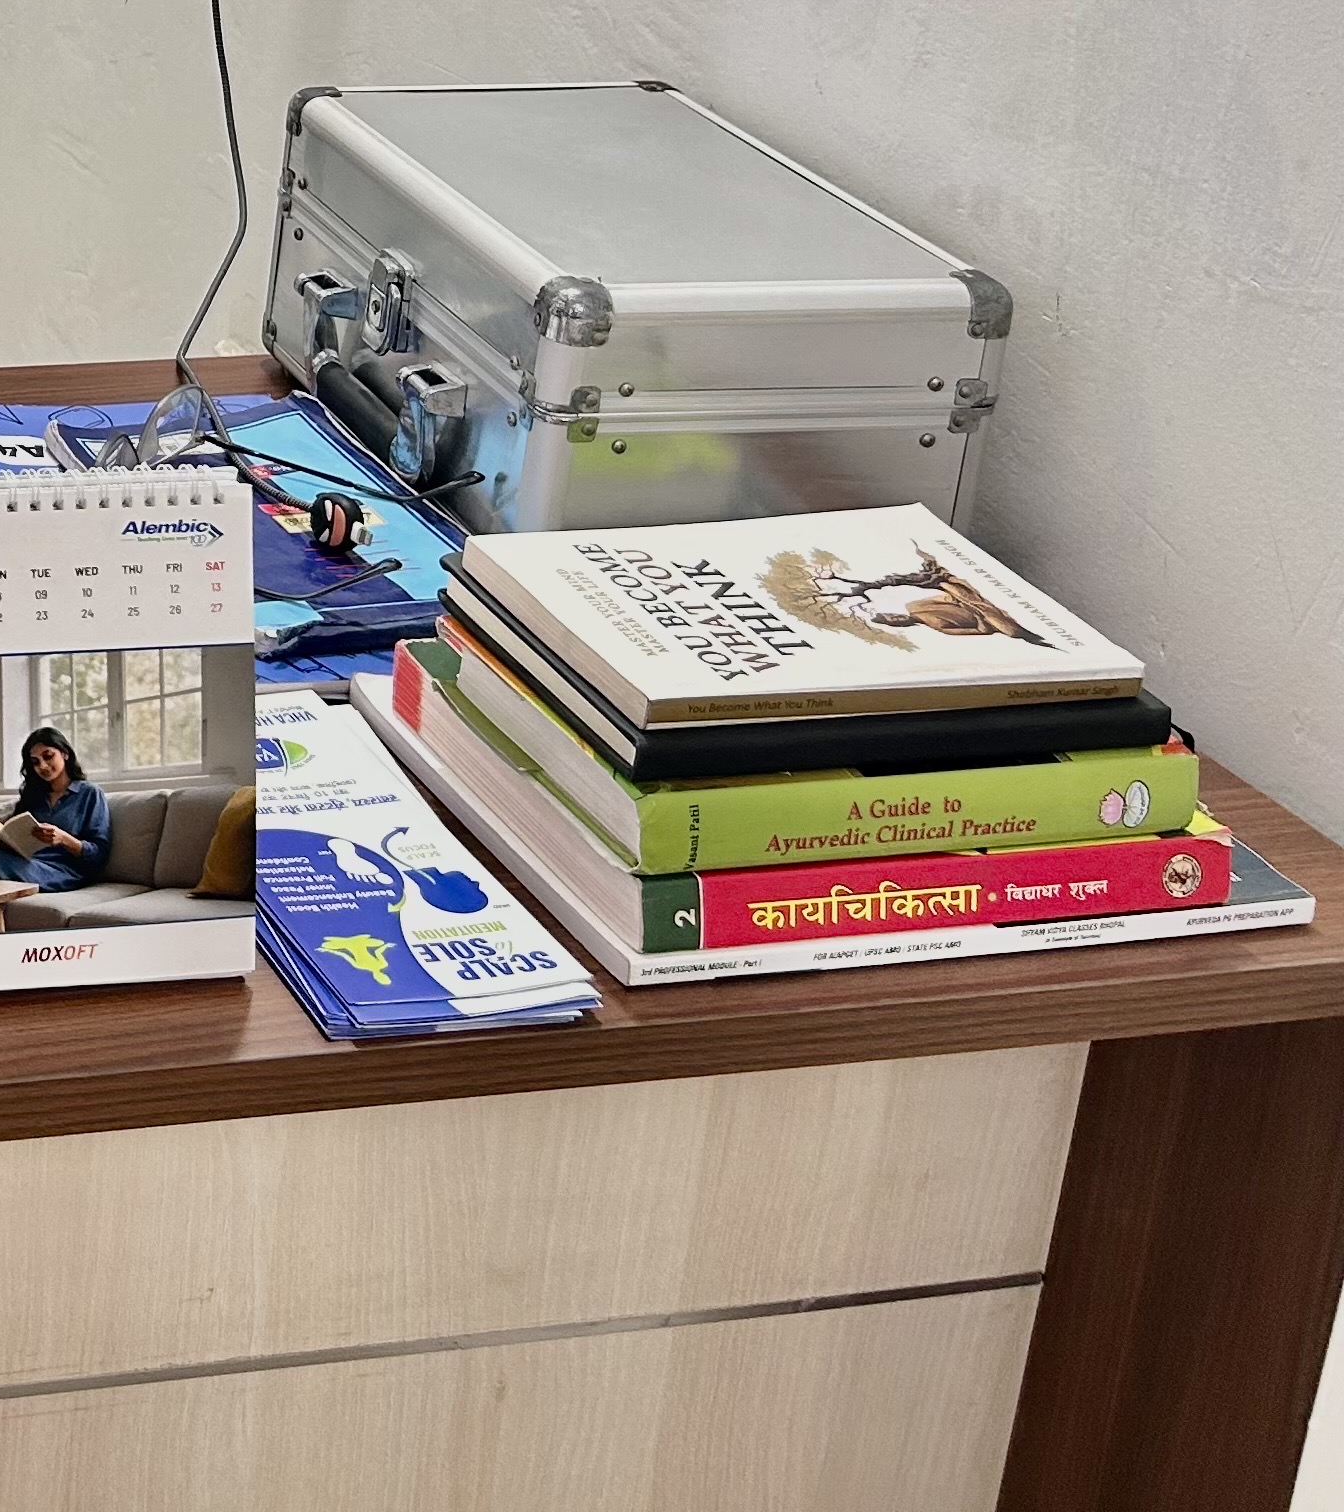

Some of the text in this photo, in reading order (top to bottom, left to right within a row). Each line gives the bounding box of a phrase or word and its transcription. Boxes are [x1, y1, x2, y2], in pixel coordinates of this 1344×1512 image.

[121, 518, 209, 535] Alembic
[29, 568, 52, 579] TUE
[74, 566, 100, 577] WED
[120, 564, 144, 575] THU
[165, 562, 183, 573] FRI
[205, 560, 226, 572] SAT
[34, 589, 48, 601] 09
[81, 587, 93, 598] 10
[128, 585, 138, 596] 11
[169, 583, 181, 594] 12
[210, 582, 222, 593] 13
[934, 539, 1085, 647] SHUBHAM KUMAR SINGH
[35, 610, 49, 621] 23
[80, 608, 95, 619] 24
[127, 606, 141, 617] 25
[168, 604, 182, 615] 26
[210, 602, 224, 614] 27
[556, 568, 659, 657] MASTER YOUR MIND
[571, 570, 669, 654] MASTER YOUR LIFE
[572, 543, 750, 681] YOU BECOME
[613, 548, 780, 673] WHAT YOU
[670, 559, 815, 656] THINK
[687, 697, 834, 713] You Become What You Think
[275, 711, 318, 725] VHCA
[279, 803, 303, 815] और
[847, 796, 962, 820] A Guide to
[683, 804, 700, 871] Vasant Patil
[764, 815, 1037, 856] Ayurvedic Clinical Practice
[397, 843, 436, 853] FOCUS
[405, 850, 441, 861] SCALP
[263, 874, 336, 884] Full Presence
[270, 884, 336, 894] Inner Peace
[278, 889, 396, 903] Beauty Enhancement
[285, 902, 360, 913] Health Boost
[746, 879, 1109, 931] कायचिकित्सा विद्याधर शुक्ल
[674, 908, 696, 927] 2
[411, 920, 507, 940] MEDITATION
[21, 943, 99, 963] MOXOFT
[412, 938, 497, 963] SOLE
[457, 951, 558, 981] SCALP
